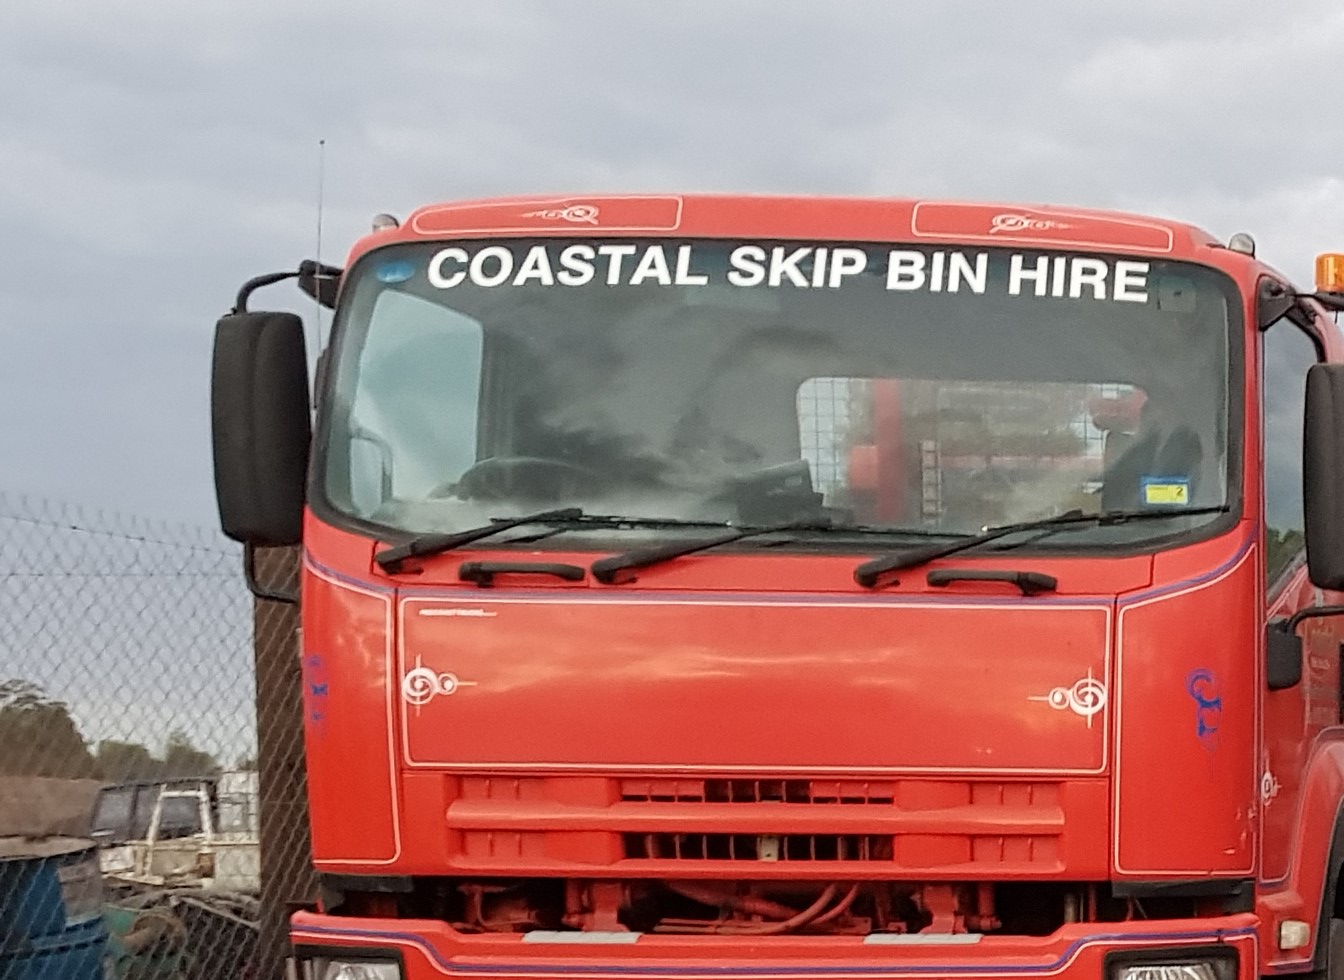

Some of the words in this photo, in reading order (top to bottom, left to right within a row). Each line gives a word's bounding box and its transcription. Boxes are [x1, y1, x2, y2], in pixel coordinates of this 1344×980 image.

[427, 244, 709, 288] COASTAL
[727, 246, 867, 288] SKIP
[886, 249, 989, 294] BIN
[1008, 253, 1150, 303] HIRE
